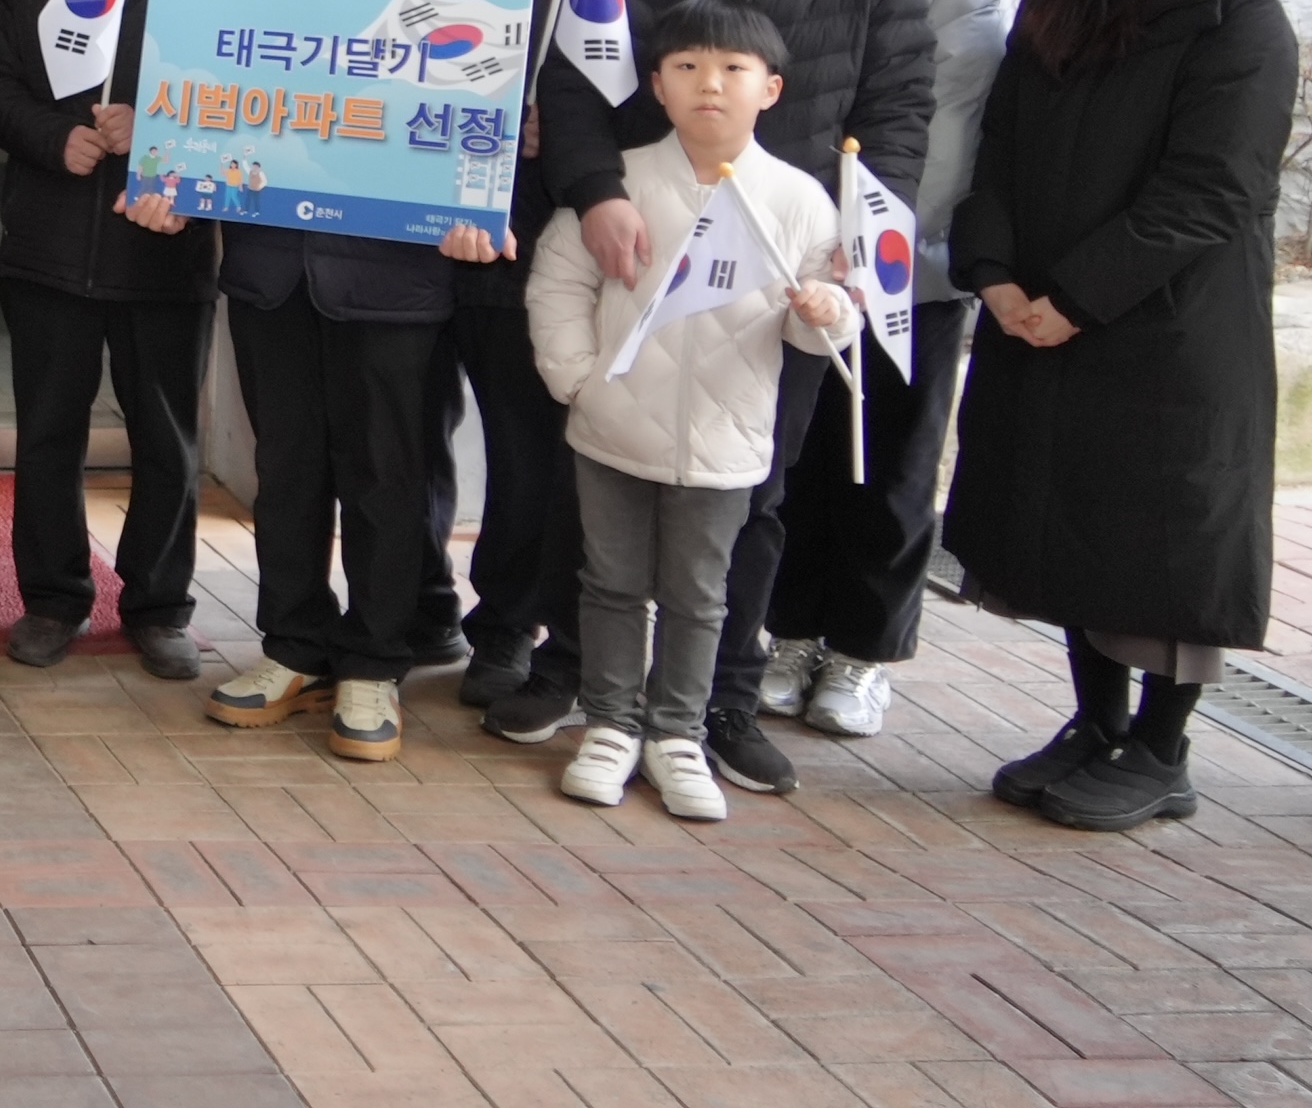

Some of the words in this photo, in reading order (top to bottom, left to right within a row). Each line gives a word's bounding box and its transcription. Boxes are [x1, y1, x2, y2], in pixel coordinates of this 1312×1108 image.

[216, 28, 430, 83] 태극기달기
[146, 79, 385, 140] 시범아파트
[406, 102, 506, 155] 선정
[315, 207, 343, 220] 춘천시
